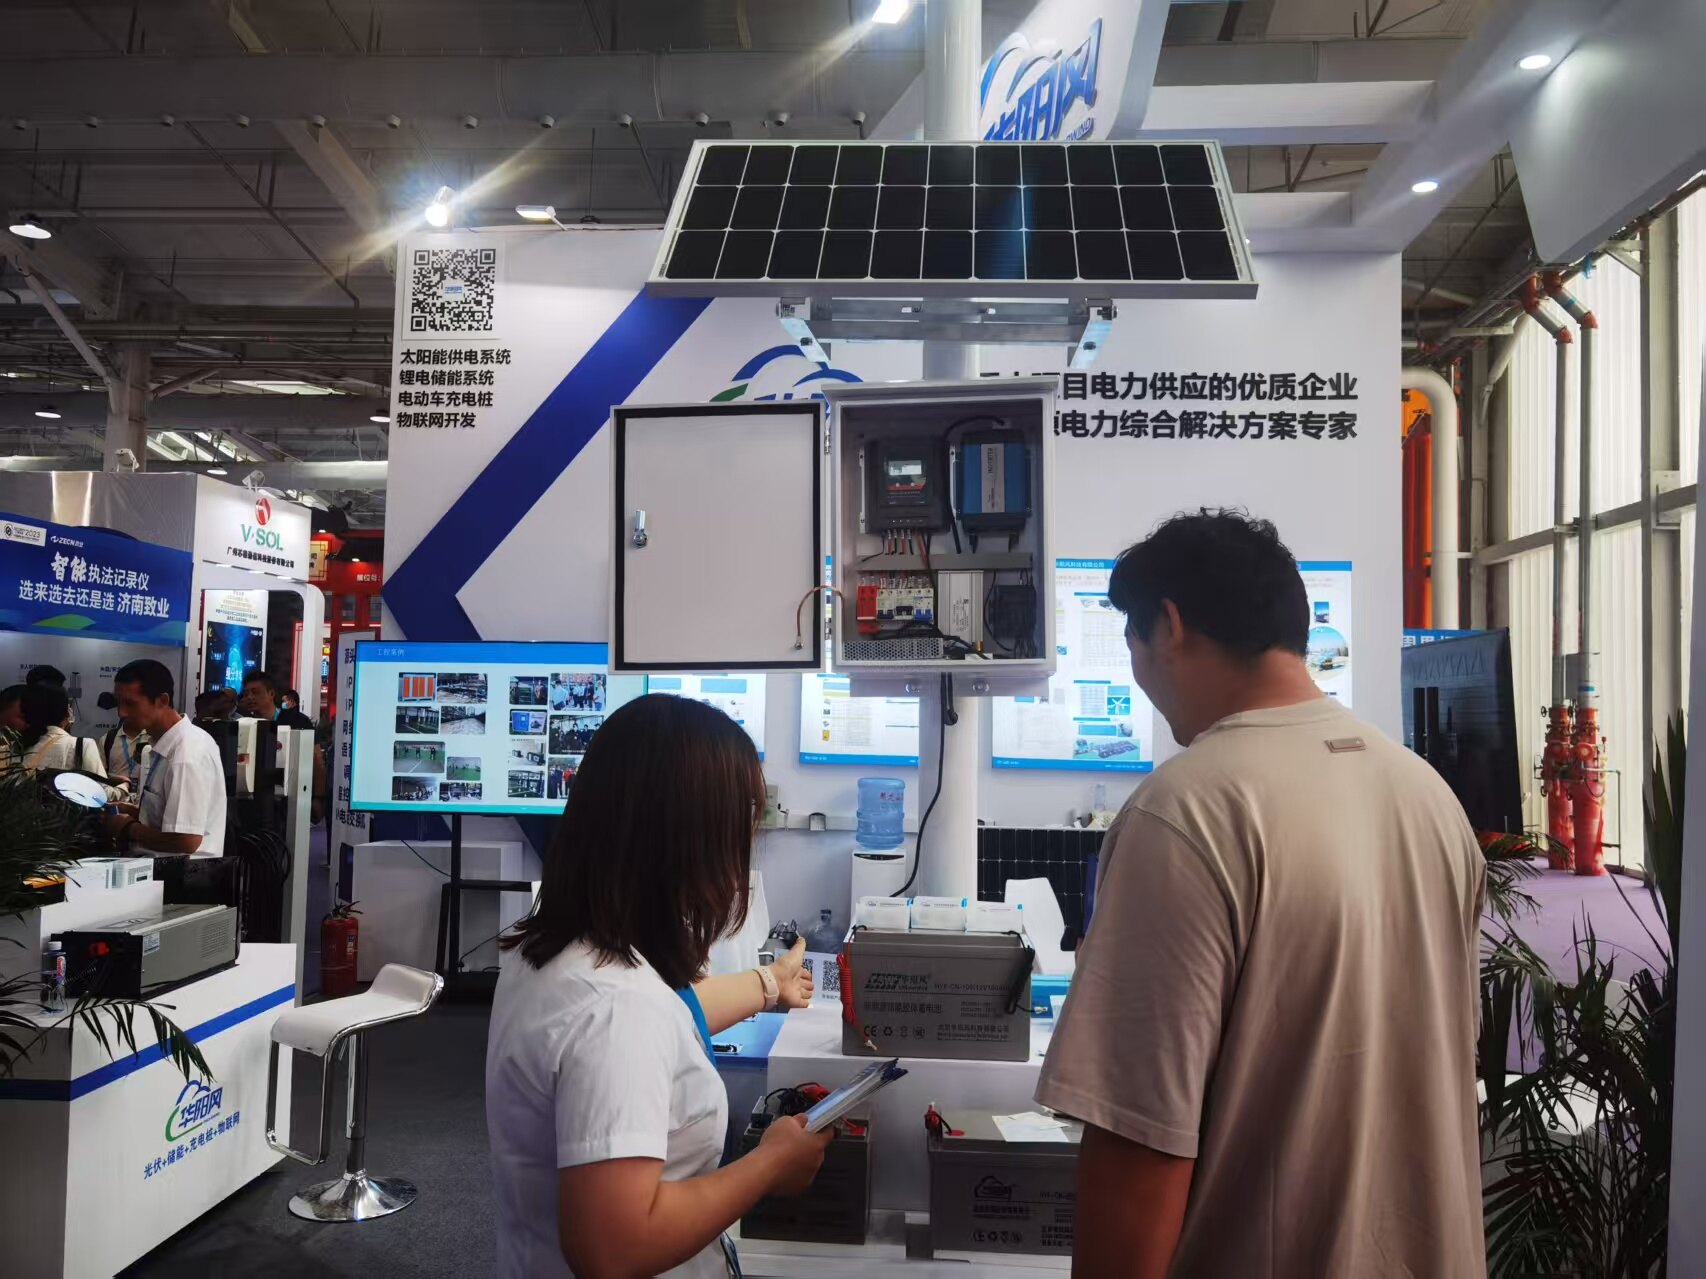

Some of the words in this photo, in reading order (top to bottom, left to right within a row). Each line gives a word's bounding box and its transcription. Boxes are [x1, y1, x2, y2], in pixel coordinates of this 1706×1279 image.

[400, 348, 511, 365] 太阳能供电系统
[399, 369, 494, 386] 锂电储能系统
[980, 371, 1358, 402] 目电力供应的优质企业
[398, 391, 493, 407] 电动车充电桩
[396, 412, 476, 428] 物联网开发
[1053, 410, 1358, 441] 电力综合解决方案专家
[51, 552, 150, 591] 智能执法记录仪
[19, 579, 115, 611] 选来选去还是选
[117, 591, 170, 619] 济南致业
[143, 1111, 241, 1180] 光伏+储能+充电桩+物联网
